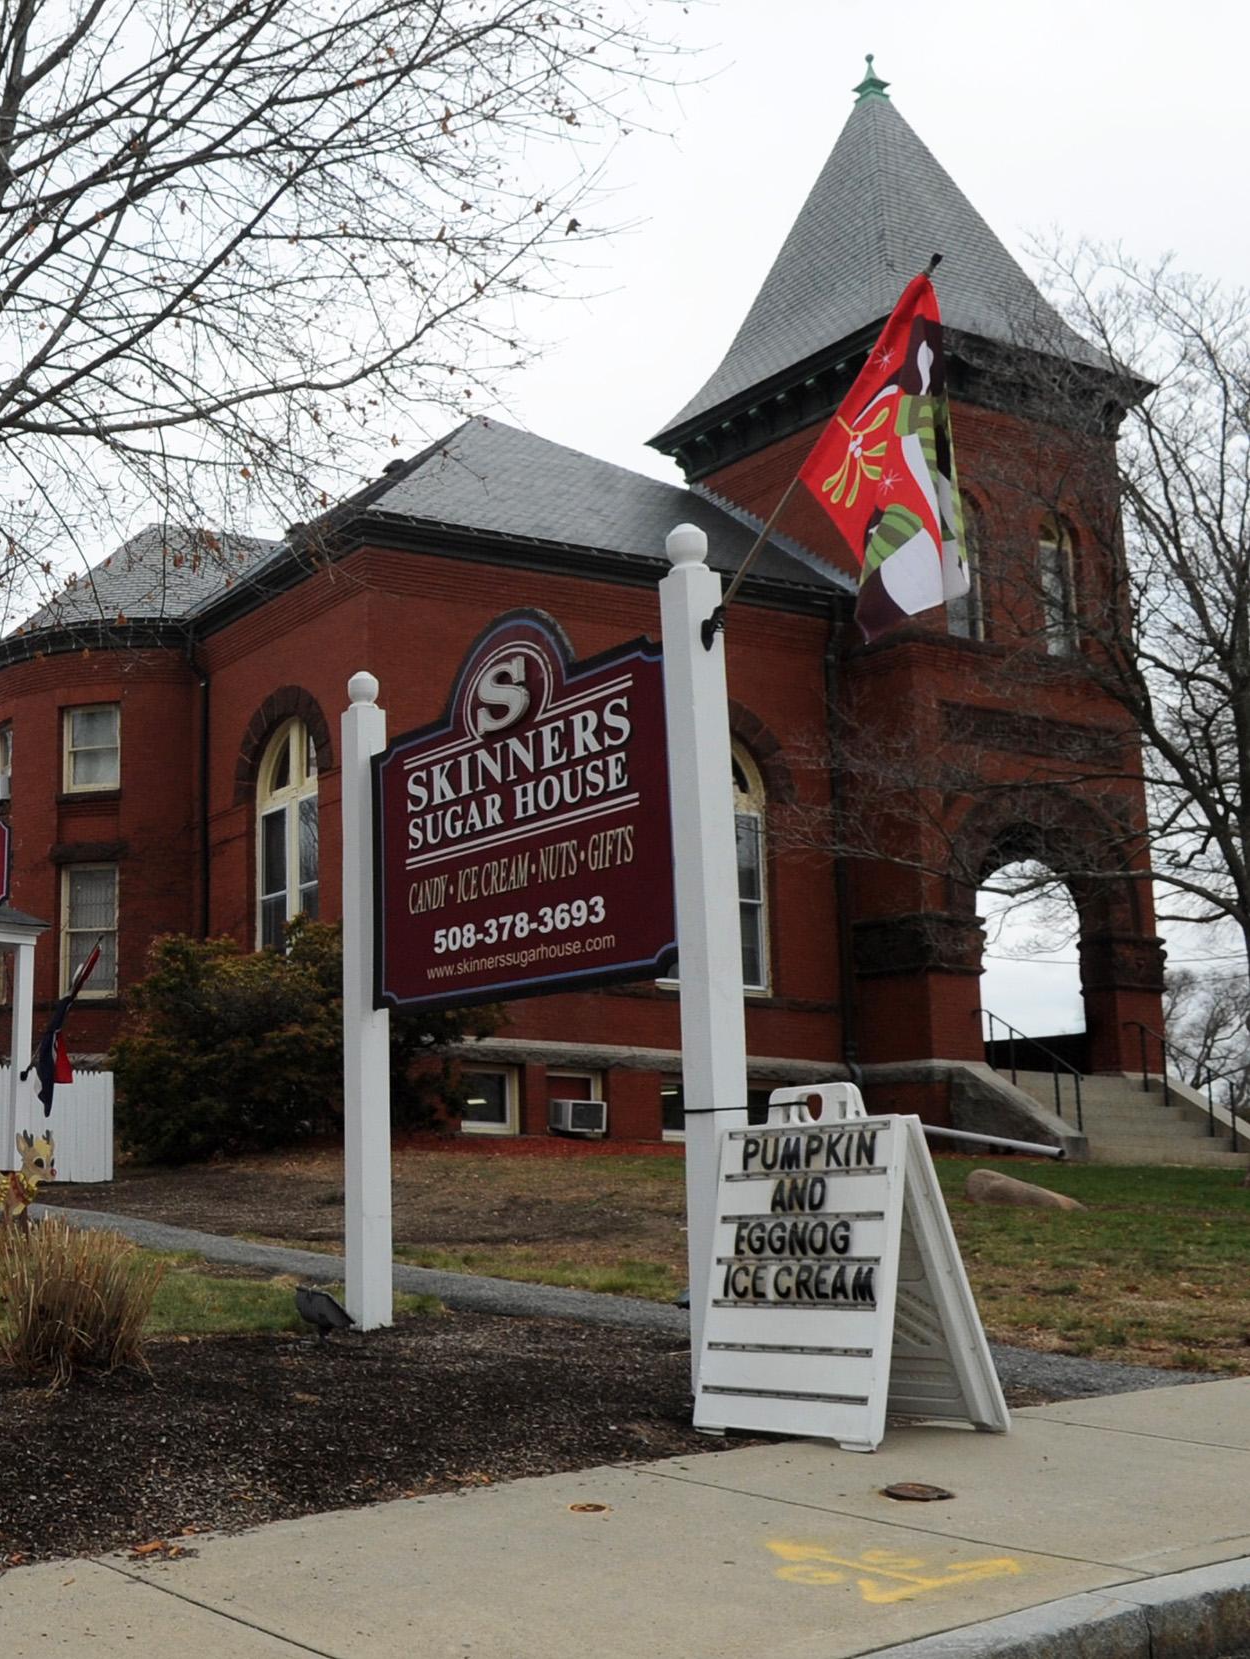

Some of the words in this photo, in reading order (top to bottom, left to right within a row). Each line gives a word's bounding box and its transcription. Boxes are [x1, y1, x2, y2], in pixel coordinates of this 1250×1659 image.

[477, 656, 530, 736] S
[407, 696, 631, 813] SKINNERS
[408, 793, 504, 850] SUGAR
[513, 752, 629, 819] HOUSE
[408, 874, 449, 915] CANDY
[456, 865, 479, 903] ICE
[481, 852, 530, 897] CREAM
[538, 840, 578, 883] NUTS
[588, 825, 634, 871] GIFTS
[433, 896, 606, 954] 508-378-3693
[426, 933, 616, 980] www.skinnerssugarhouse.com
[743, 1130, 877, 1171] PUMPKIN
[771, 1177, 827, 1212] AND
[734, 1220, 851, 1256] EGGNOG
[723, 1264, 768, 1299] ICE
[773, 1264, 877, 1301] CREAM
